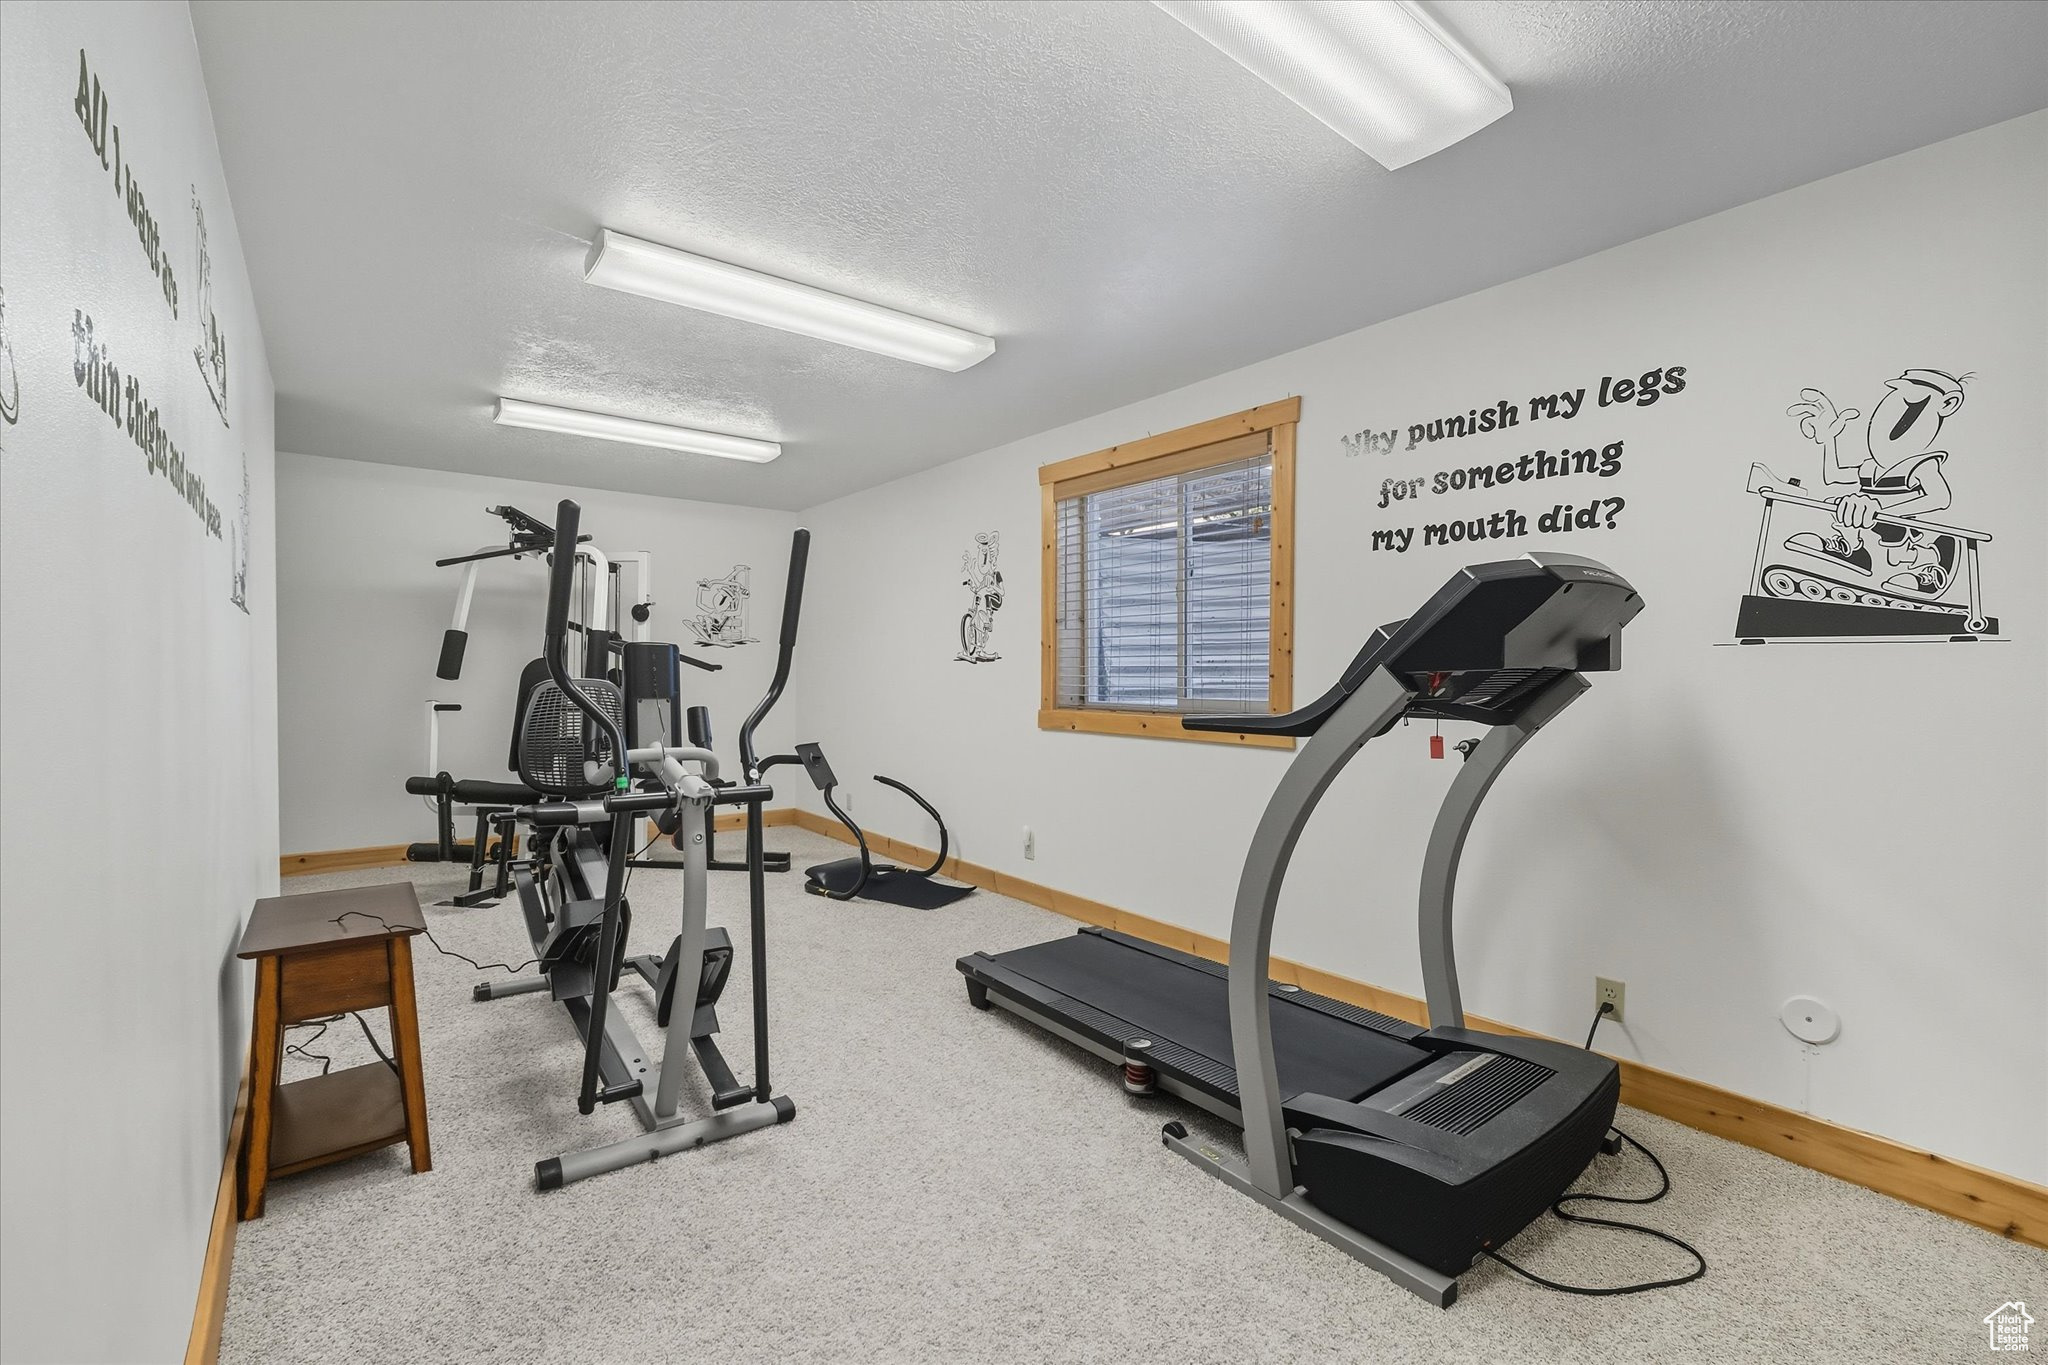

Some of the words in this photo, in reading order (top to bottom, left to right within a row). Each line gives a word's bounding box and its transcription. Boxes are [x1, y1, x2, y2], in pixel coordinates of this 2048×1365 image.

[74, 48, 109, 171] All
[125, 163, 160, 278] want
[162, 251, 178, 320] are
[72, 308, 122, 429] thin
[125, 374, 168, 476] thighs
[169, 440, 185, 498] and
[186, 468, 205, 522] world
[1340, 428, 1398, 458] Why
[1405, 400, 1519, 452] punish
[1528, 388, 1586, 420] my
[1597, 365, 1687, 407] legs
[1377, 476, 1425, 509] for
[1431, 440, 1625, 495] something
[1371, 526, 1414, 553] my
[1423, 509, 1528, 546] mouth
[1537, 496, 1626, 534] did?
